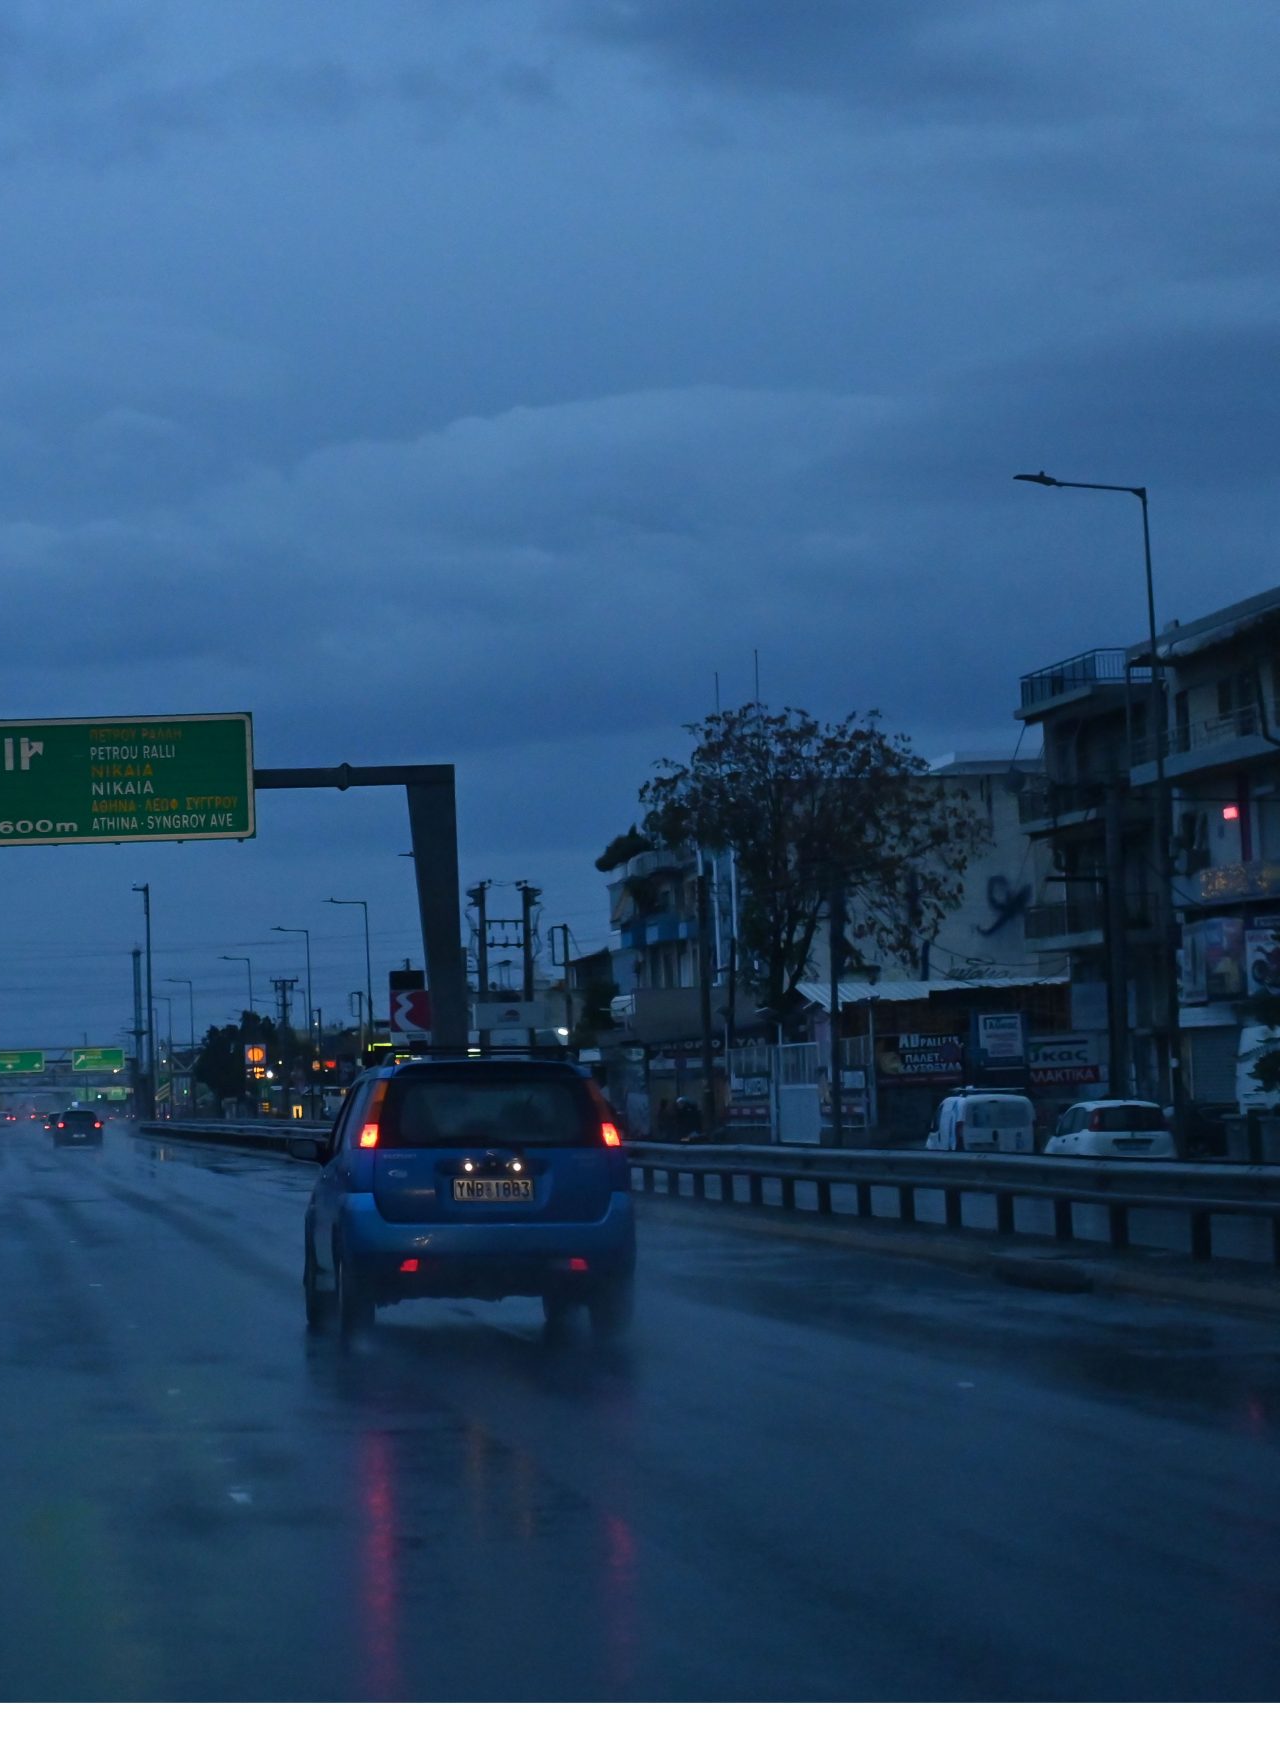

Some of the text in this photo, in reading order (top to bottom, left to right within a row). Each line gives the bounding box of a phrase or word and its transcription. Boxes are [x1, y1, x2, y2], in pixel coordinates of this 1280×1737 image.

[90, 744, 176, 760] PETROU RALLI
[92, 780, 154, 796] NIKAIA
[92, 816, 138, 830] ATHINA
[147, 813, 206, 829] SYNGROY
[210, 813, 233, 827] AVE
